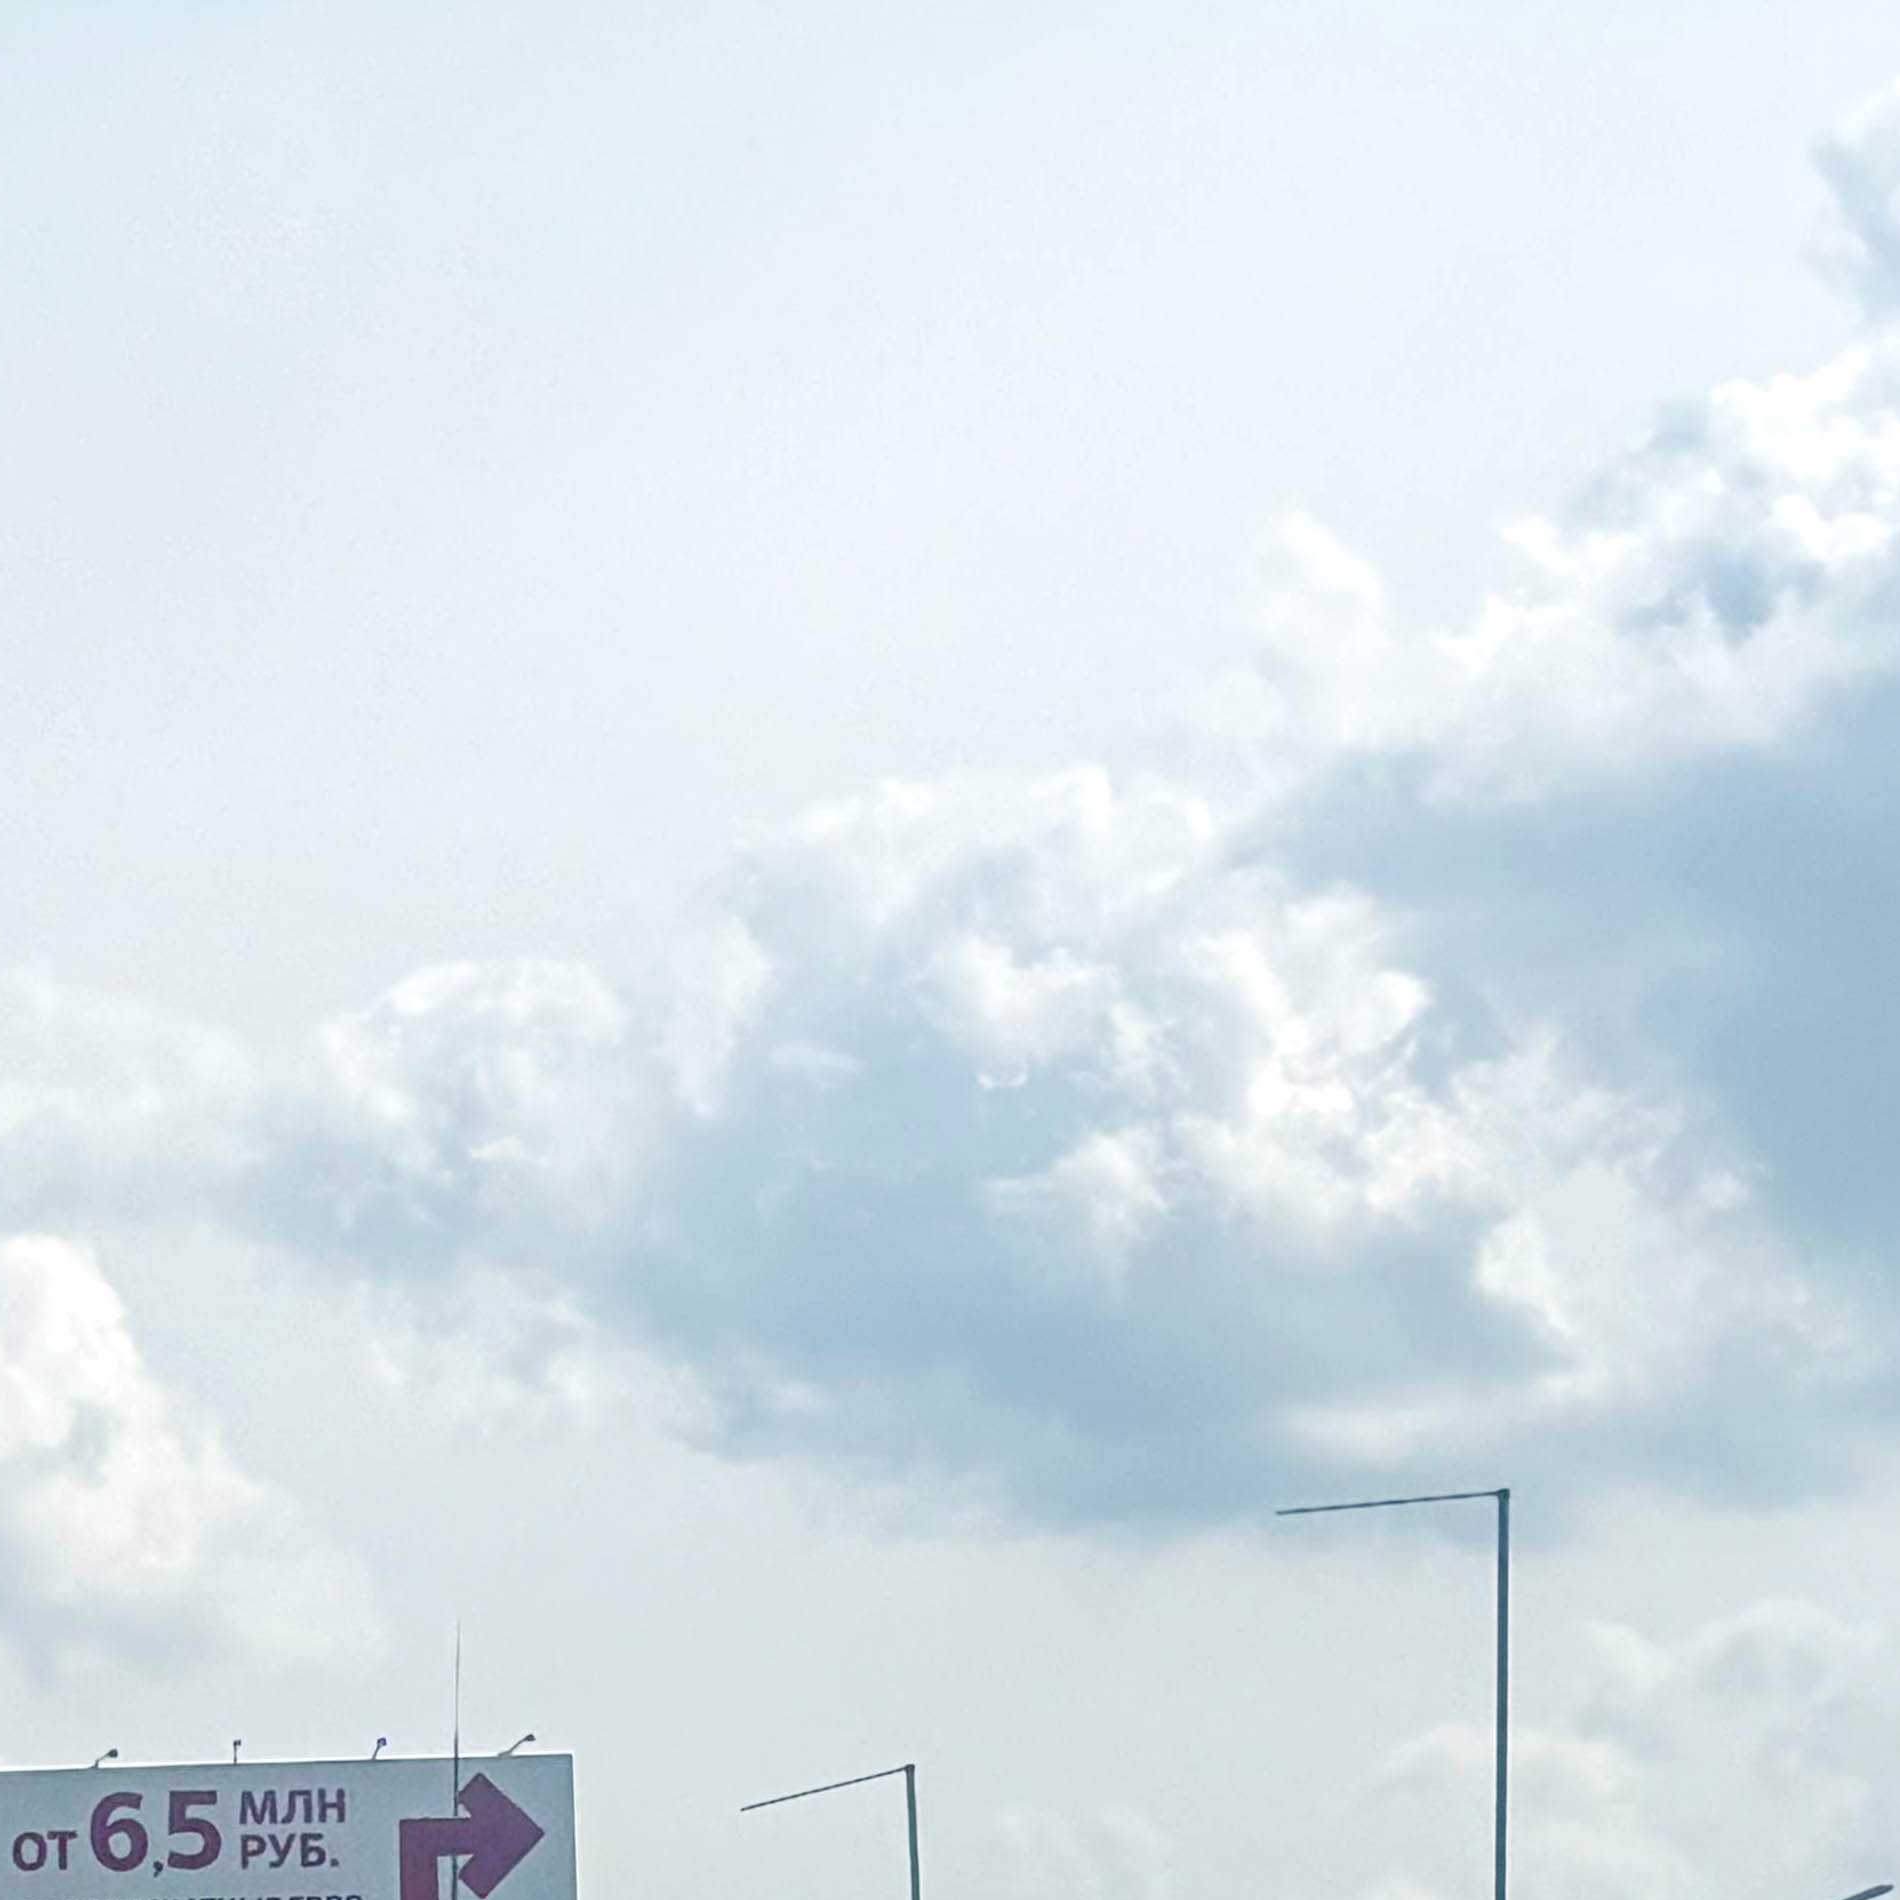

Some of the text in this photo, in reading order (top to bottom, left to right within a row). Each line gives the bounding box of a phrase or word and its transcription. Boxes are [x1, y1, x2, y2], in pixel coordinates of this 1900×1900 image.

[239, 1788, 346, 1825] МЛН
[89, 1789, 222, 1878] 6,5
[240, 1833, 339, 1870] РУБ.
